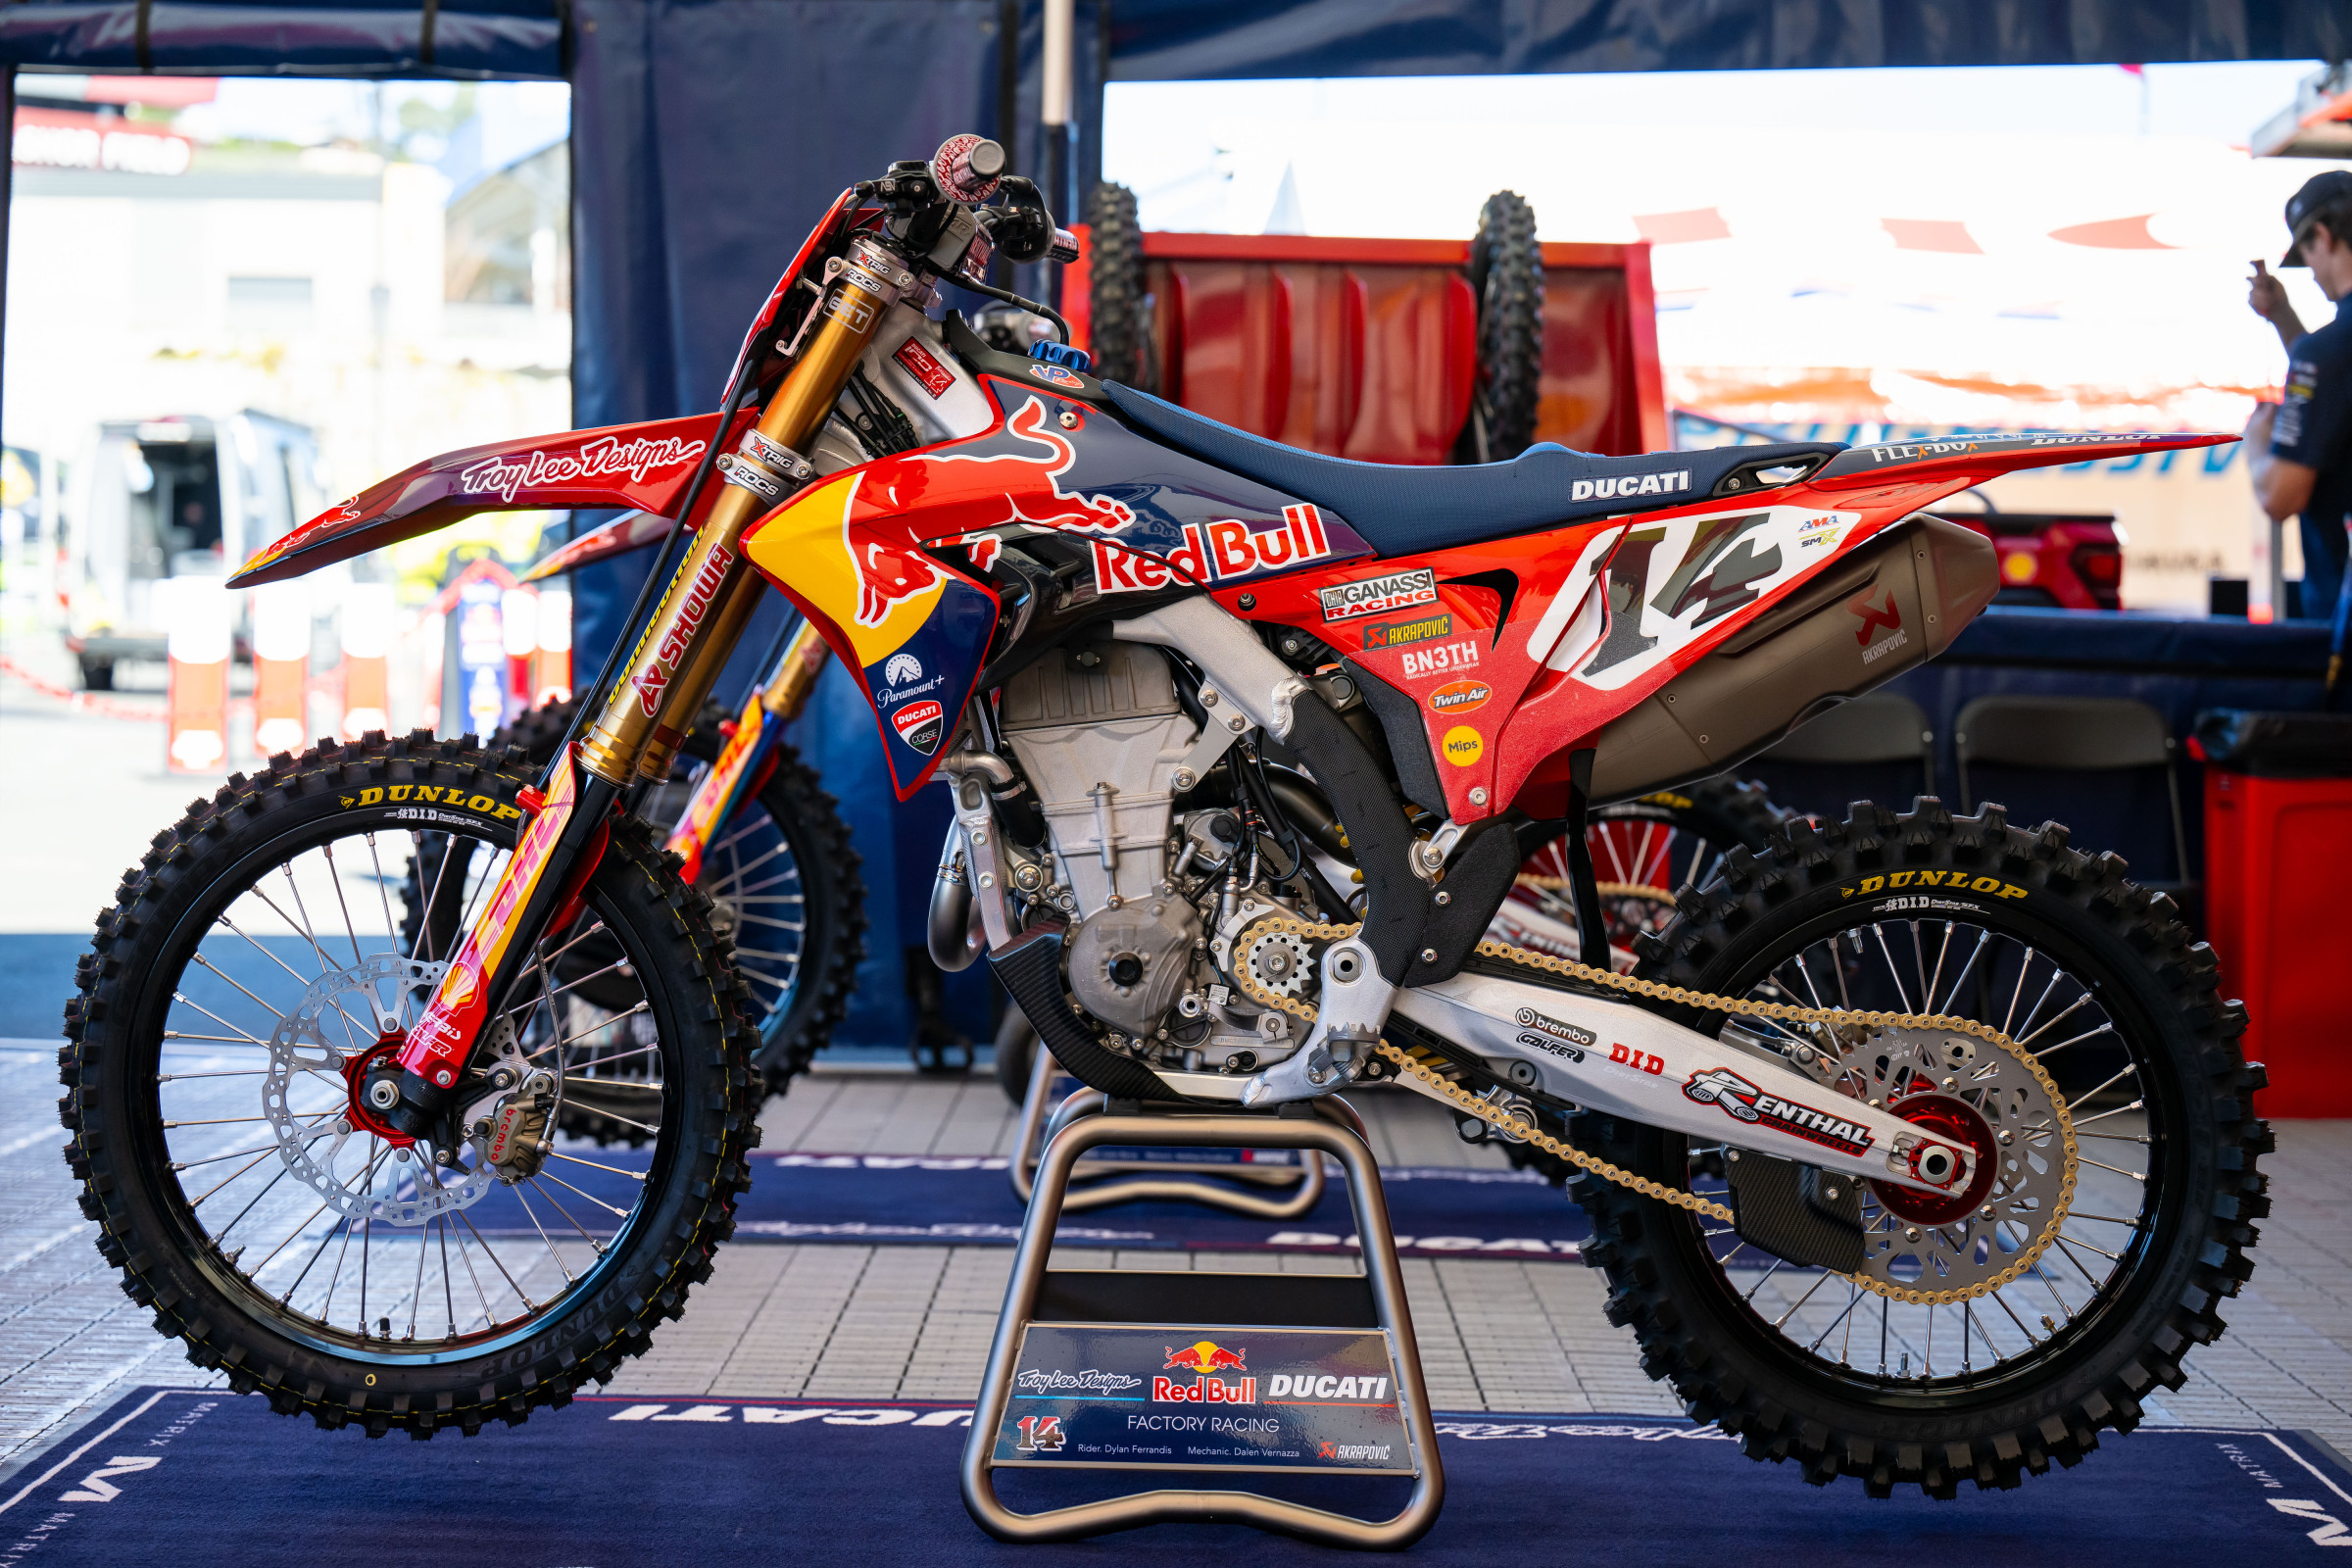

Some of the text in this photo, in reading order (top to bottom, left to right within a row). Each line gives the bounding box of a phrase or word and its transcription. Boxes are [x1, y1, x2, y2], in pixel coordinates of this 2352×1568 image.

[857, 250, 893, 275] XTRIG
[846, 269, 882, 292] ROCS
[828, 296, 869, 324] GET
[1032, 365, 1070, 383] VP
[750, 436, 795, 469] XTRIG
[461, 435, 707, 503] Troy Lee Designs
[734, 466, 781, 497] ROCS
[1571, 470, 1689, 501] DUCATI
[1798, 514, 1839, 532] AMA
[1091, 503, 1331, 594] Red Bull
[1324, 571, 1433, 609] CHIP GANASSI
[1326, 590, 1436, 618] RACING
[1582, 512, 1784, 678] 14
[659, 542, 735, 671] SHOWA
[1389, 615, 1448, 645] AKRAPOVIČ
[1402, 640, 1479, 674] BN3TH
[1862, 628, 1908, 666] AKRAPOVIČ
[877, 674, 946, 710] Paramount+
[1434, 687, 1490, 709] Twin Air
[897, 705, 938, 725] DUCATI
[911, 728, 938, 744] CORSE
[1447, 740, 1479, 754] Mips
[358, 784, 522, 820] DUNLOP
[487, 810, 561, 930] DHL
[1857, 870, 2029, 900] DUNLOP
[1536, 1015, 1591, 1045] brembo
[1519, 1032, 1579, 1062] GALFER
[1608, 1042, 1665, 1076] D.I.D
[1683, 1068, 1871, 1147] RENTHAL
[490, 1107, 517, 1161] brembo
[1761, 1115, 1863, 1155] CHAINWHEELS
[1018, 1369, 1142, 1396] Troy Lee Designs
[1152, 1376, 1256, 1404] Red Bull
[1269, 1374, 1388, 1399] DUCATI
[144, 1401, 219, 1447] MATRIX
[608, 1403, 974, 1427] UCATI
[1128, 1415, 1280, 1433] FACTORY RACING
[1016, 1415, 1066, 1452] 14
[1078, 1444, 1172, 1454] Rider. Dylan Ferrandis
[1188, 1446, 1300, 1457] Mechanic. Dalen Vernazza
[1337, 1444, 1391, 1460] AKRAPOVIČ
[2214, 1443, 2284, 1489] MATRIX
